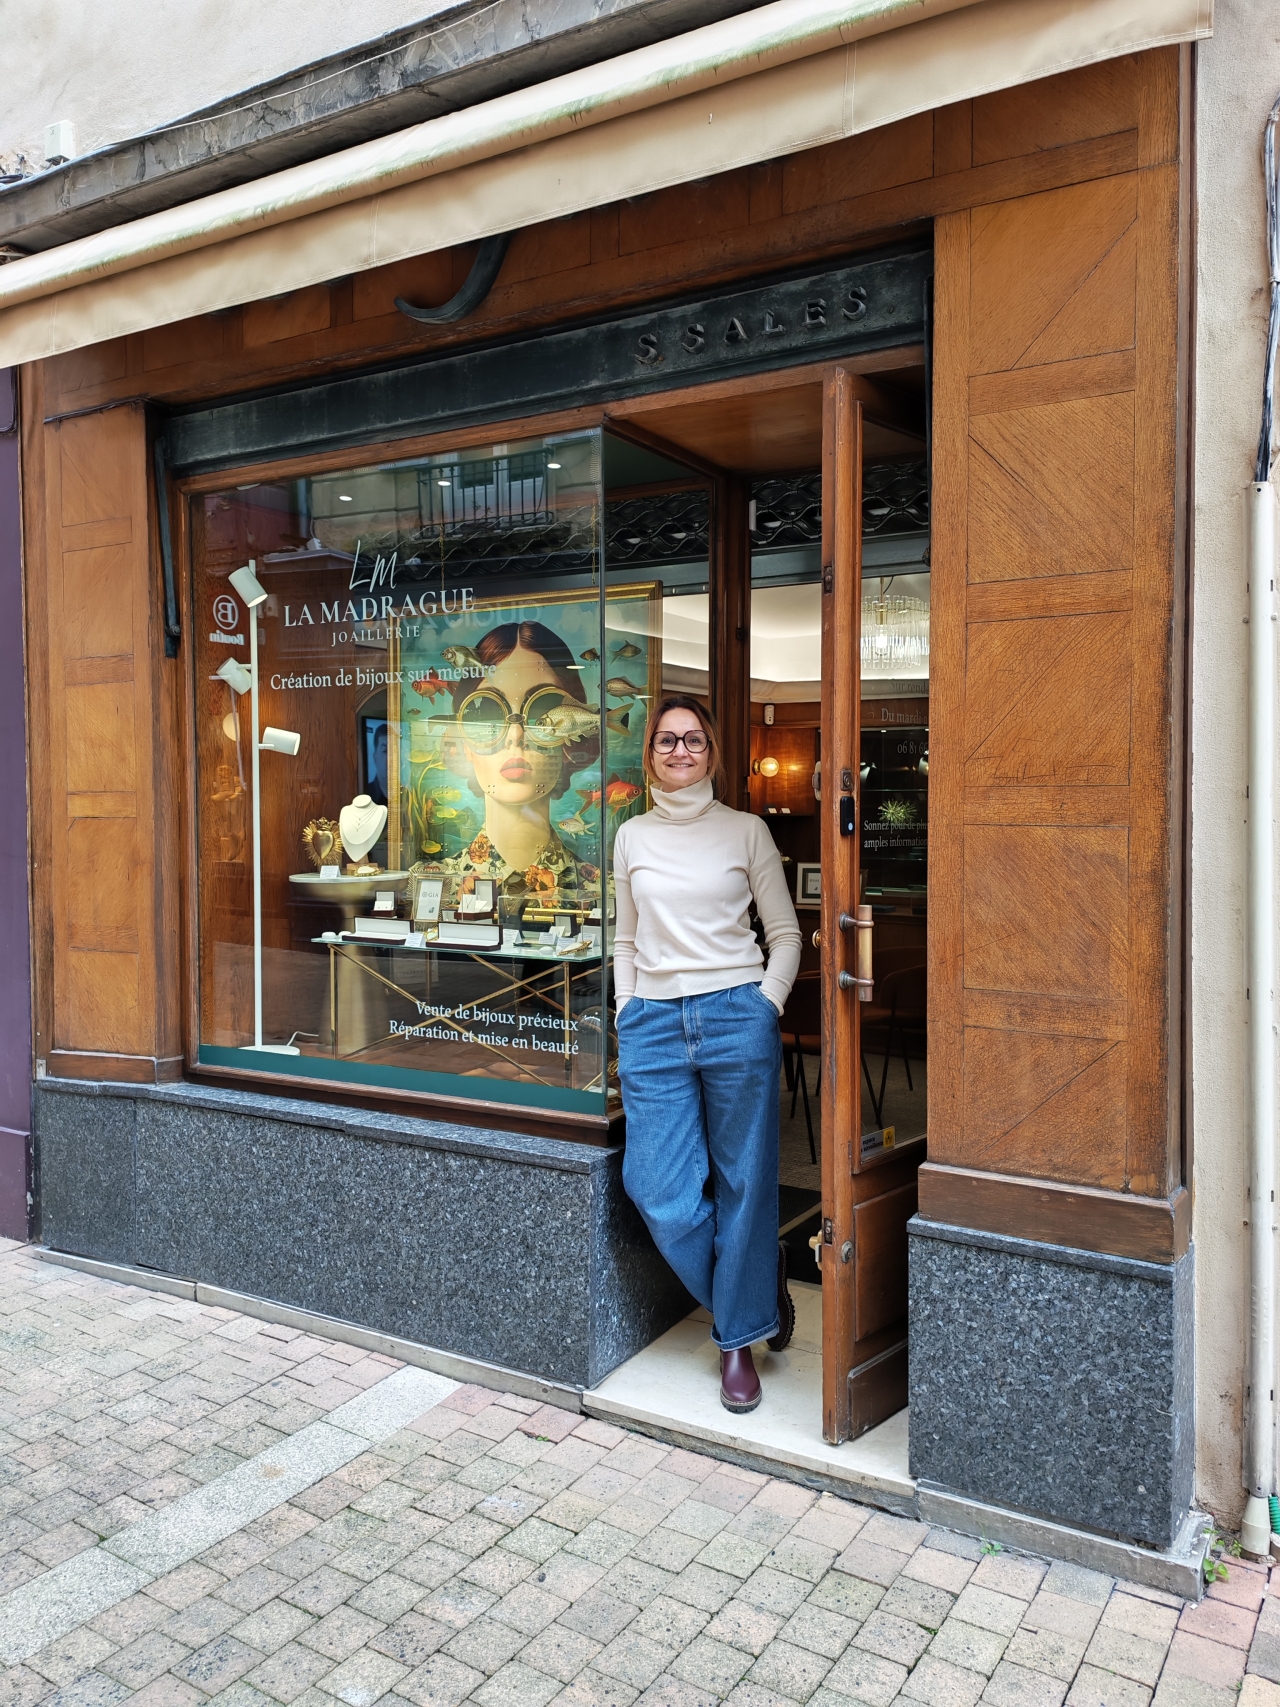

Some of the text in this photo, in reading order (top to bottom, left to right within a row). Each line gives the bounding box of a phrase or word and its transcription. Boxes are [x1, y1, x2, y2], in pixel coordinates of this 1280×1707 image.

[283, 588, 475, 627] LA MADRAGUE
[331, 625, 421, 647] JOAILLERIE
[270, 664, 496, 692] Création de bijoux sur mesure
[881, 708, 894, 722] Du
[896, 710, 921, 724] mardi
[897, 741, 907, 754] 06
[909, 741, 917, 754] 81
[863, 819, 889, 831] Sonnez
[890, 821, 906, 834] pour
[907, 819, 915, 830] de
[863, 836, 889, 851] amples
[416, 1001, 579, 1032] Vente de bijoux précieux
[389, 1020, 579, 1055] Réparation et mise en beauté
